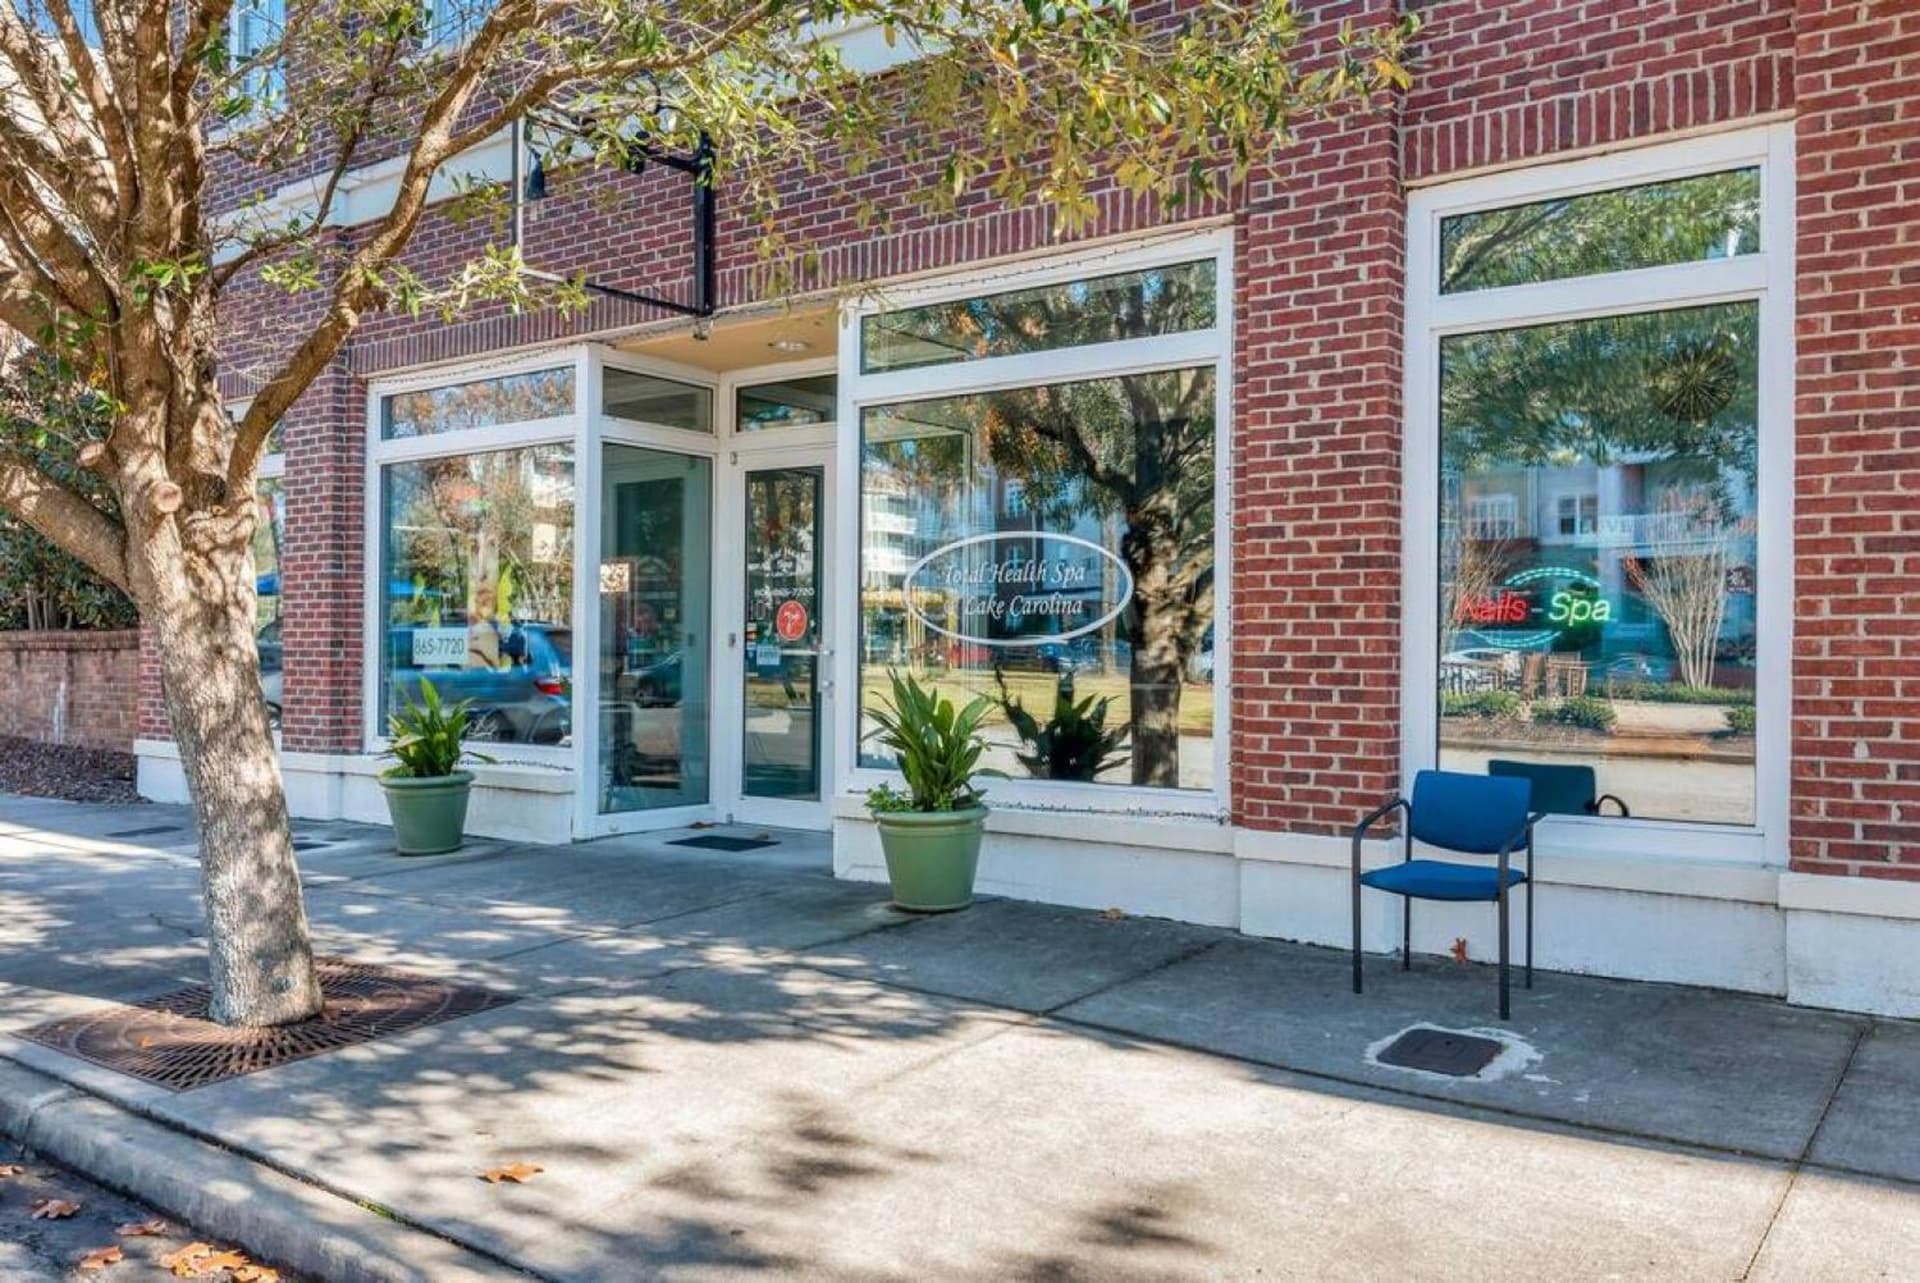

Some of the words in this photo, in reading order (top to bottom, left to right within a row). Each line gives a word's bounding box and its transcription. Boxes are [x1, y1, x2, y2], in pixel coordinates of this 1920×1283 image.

[944, 560, 988, 583] Toal
[989, 559, 1047, 584] Health
[1050, 562, 1085, 588] Spa
[964, 593, 1005, 619] Lake
[1009, 591, 1083, 617] Carolina
[1457, 589, 1527, 623] Nails
[1548, 592, 1611, 627] Spa
